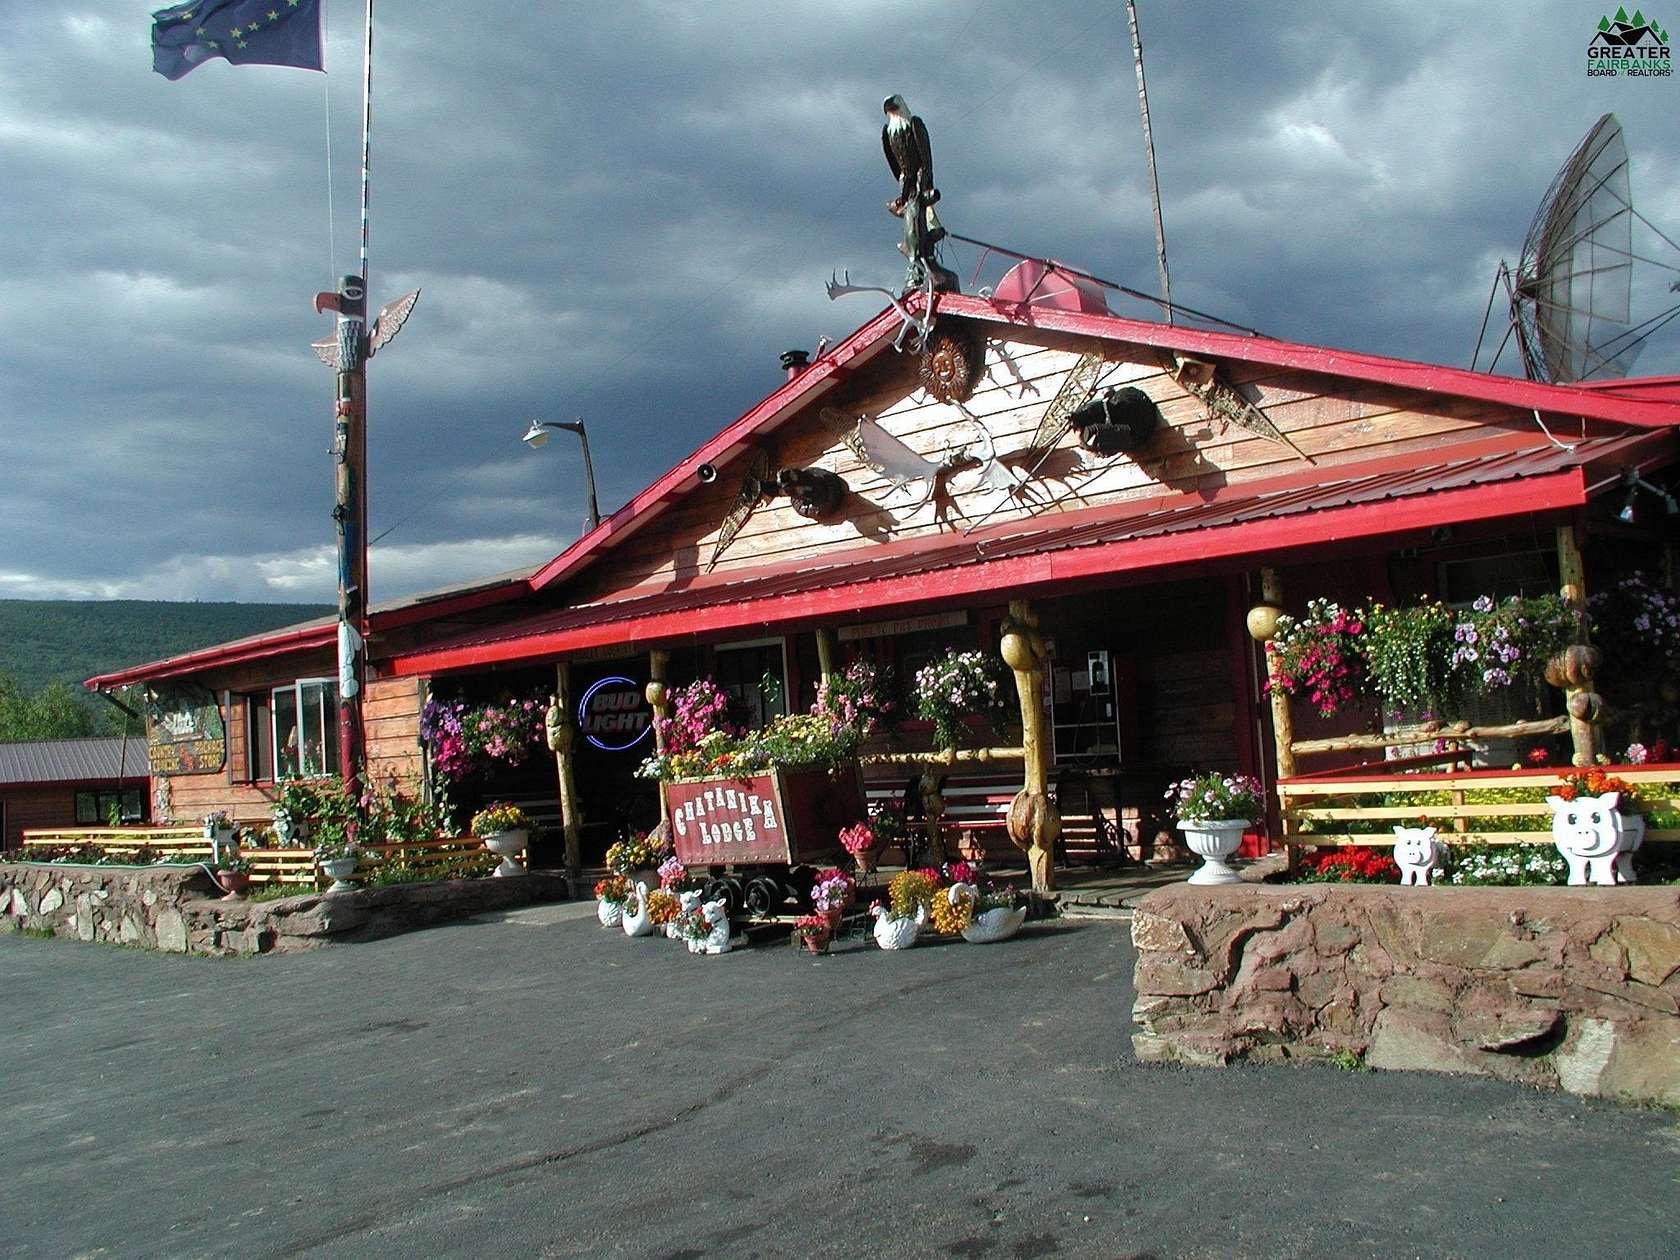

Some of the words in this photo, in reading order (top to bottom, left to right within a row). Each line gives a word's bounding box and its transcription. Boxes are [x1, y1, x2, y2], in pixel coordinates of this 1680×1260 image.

[591, 691, 642, 711] BUD
[582, 711, 650, 732] LIGHT
[674, 786, 777, 836] CHATANIKA
[699, 817, 756, 845] LODGE
